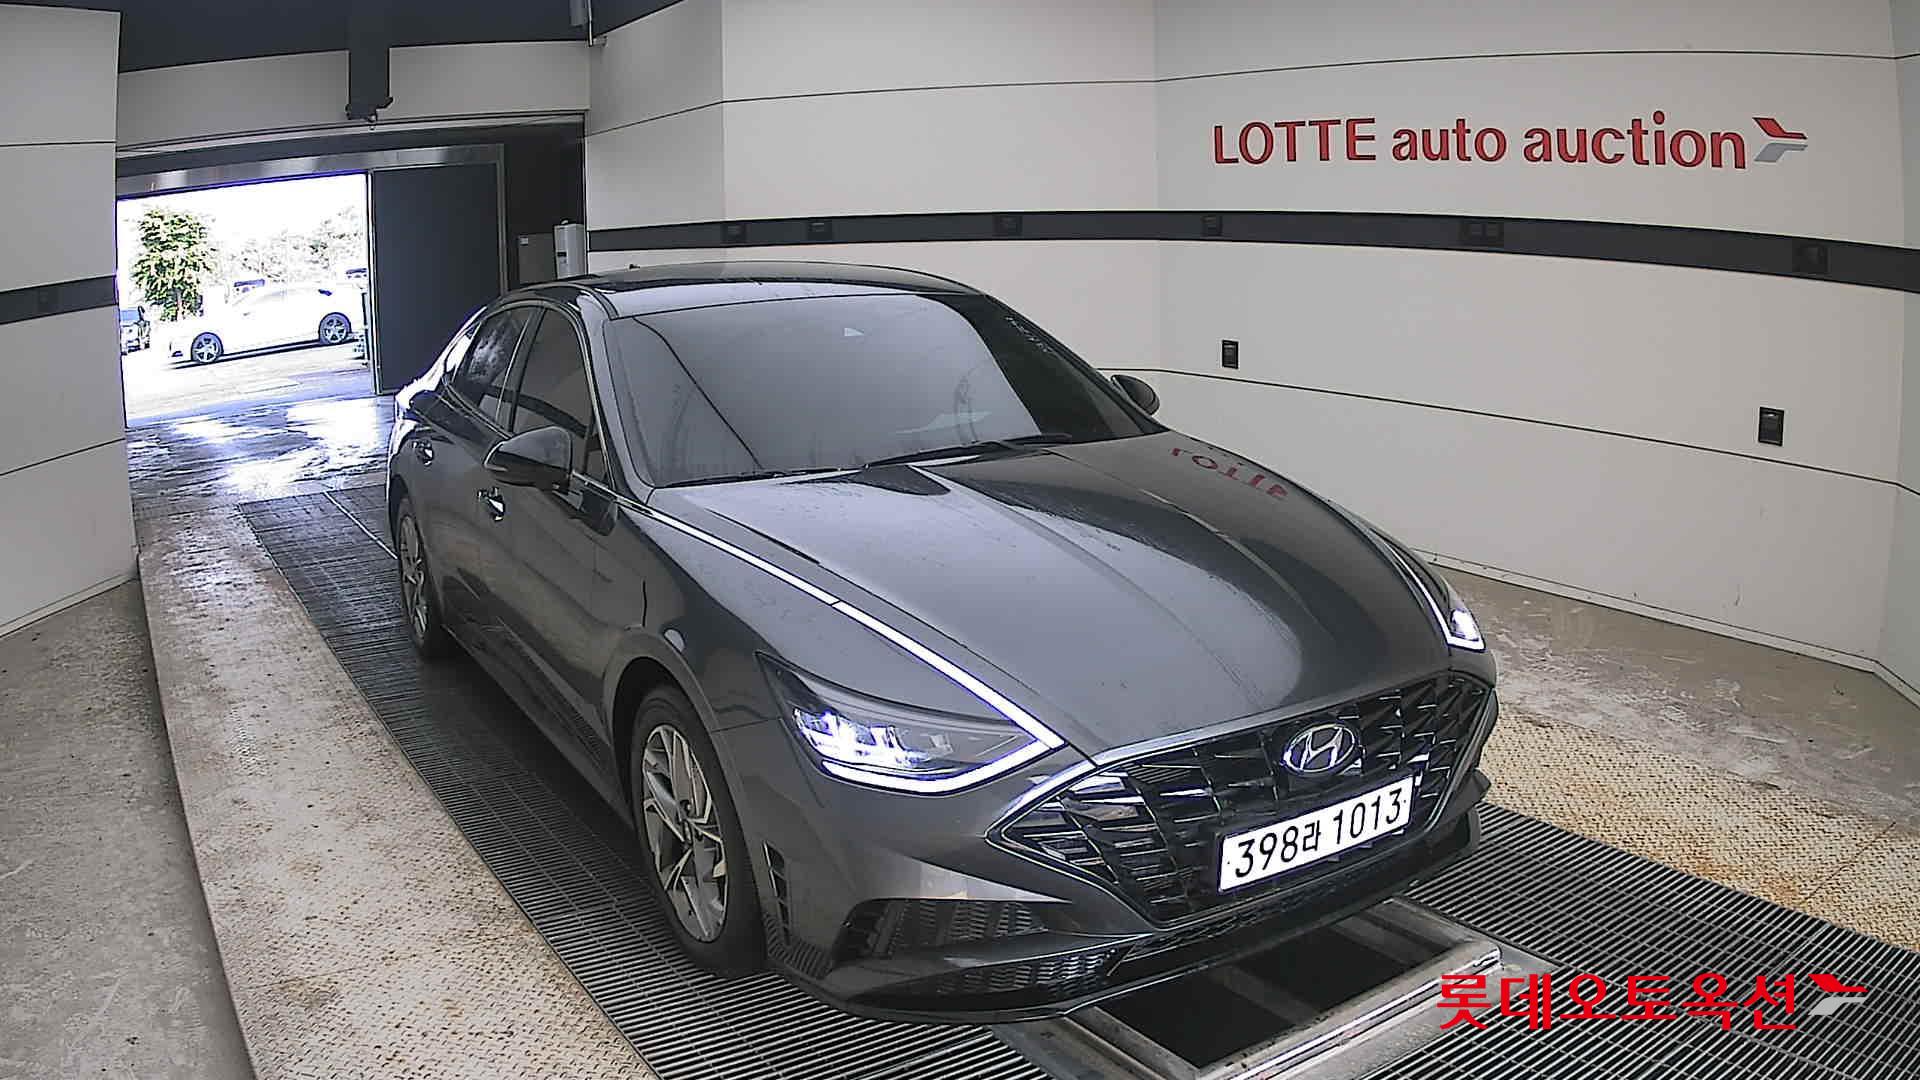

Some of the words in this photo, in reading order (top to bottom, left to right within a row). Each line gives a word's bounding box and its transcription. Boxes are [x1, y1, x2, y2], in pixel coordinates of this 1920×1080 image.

[1212, 116, 1377, 165] LOTTE
[1391, 117, 1508, 163] auto
[1522, 109, 1748, 171] auction
[1234, 819, 1322, 879] 398라
[1332, 787, 1403, 846] 1013
